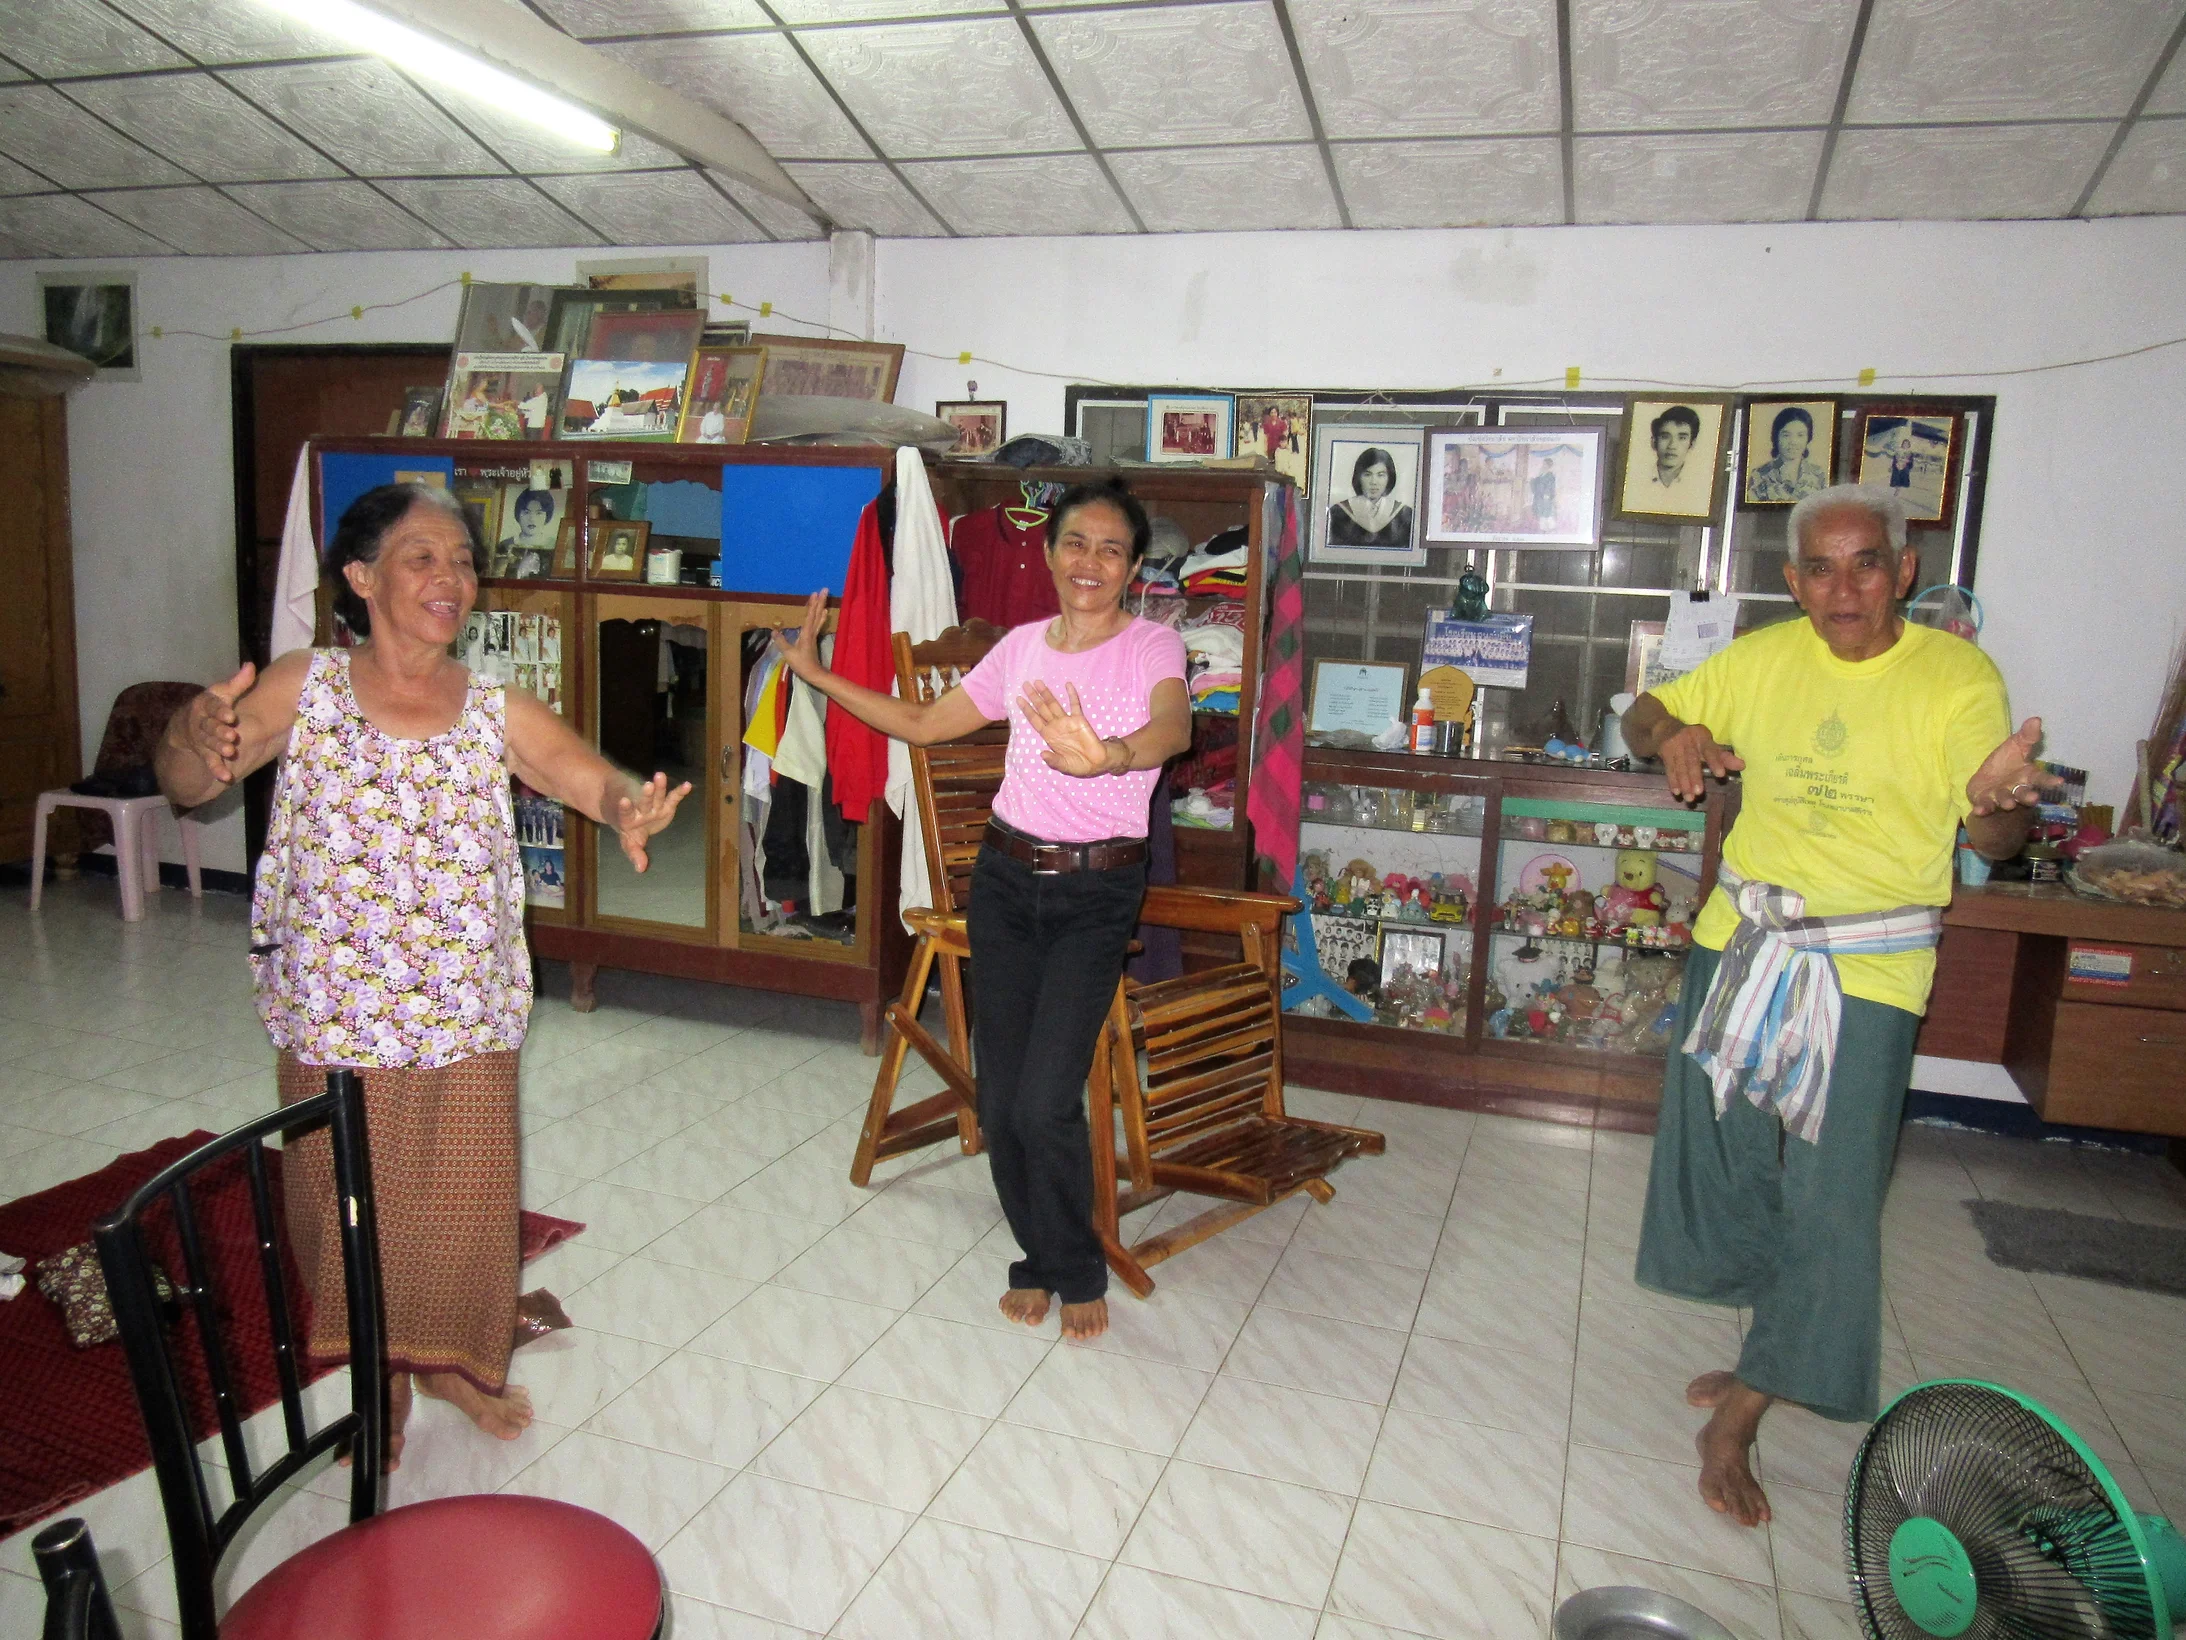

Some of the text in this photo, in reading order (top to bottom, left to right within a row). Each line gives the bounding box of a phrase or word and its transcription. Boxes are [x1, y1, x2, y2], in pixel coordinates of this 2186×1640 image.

[480, 466, 532, 482] พระเจ้าอยู่หัว
[1785, 765, 1849, 785] เฉลิมพระเกียรติ
[1840, 792, 1875, 804] พรรษา
